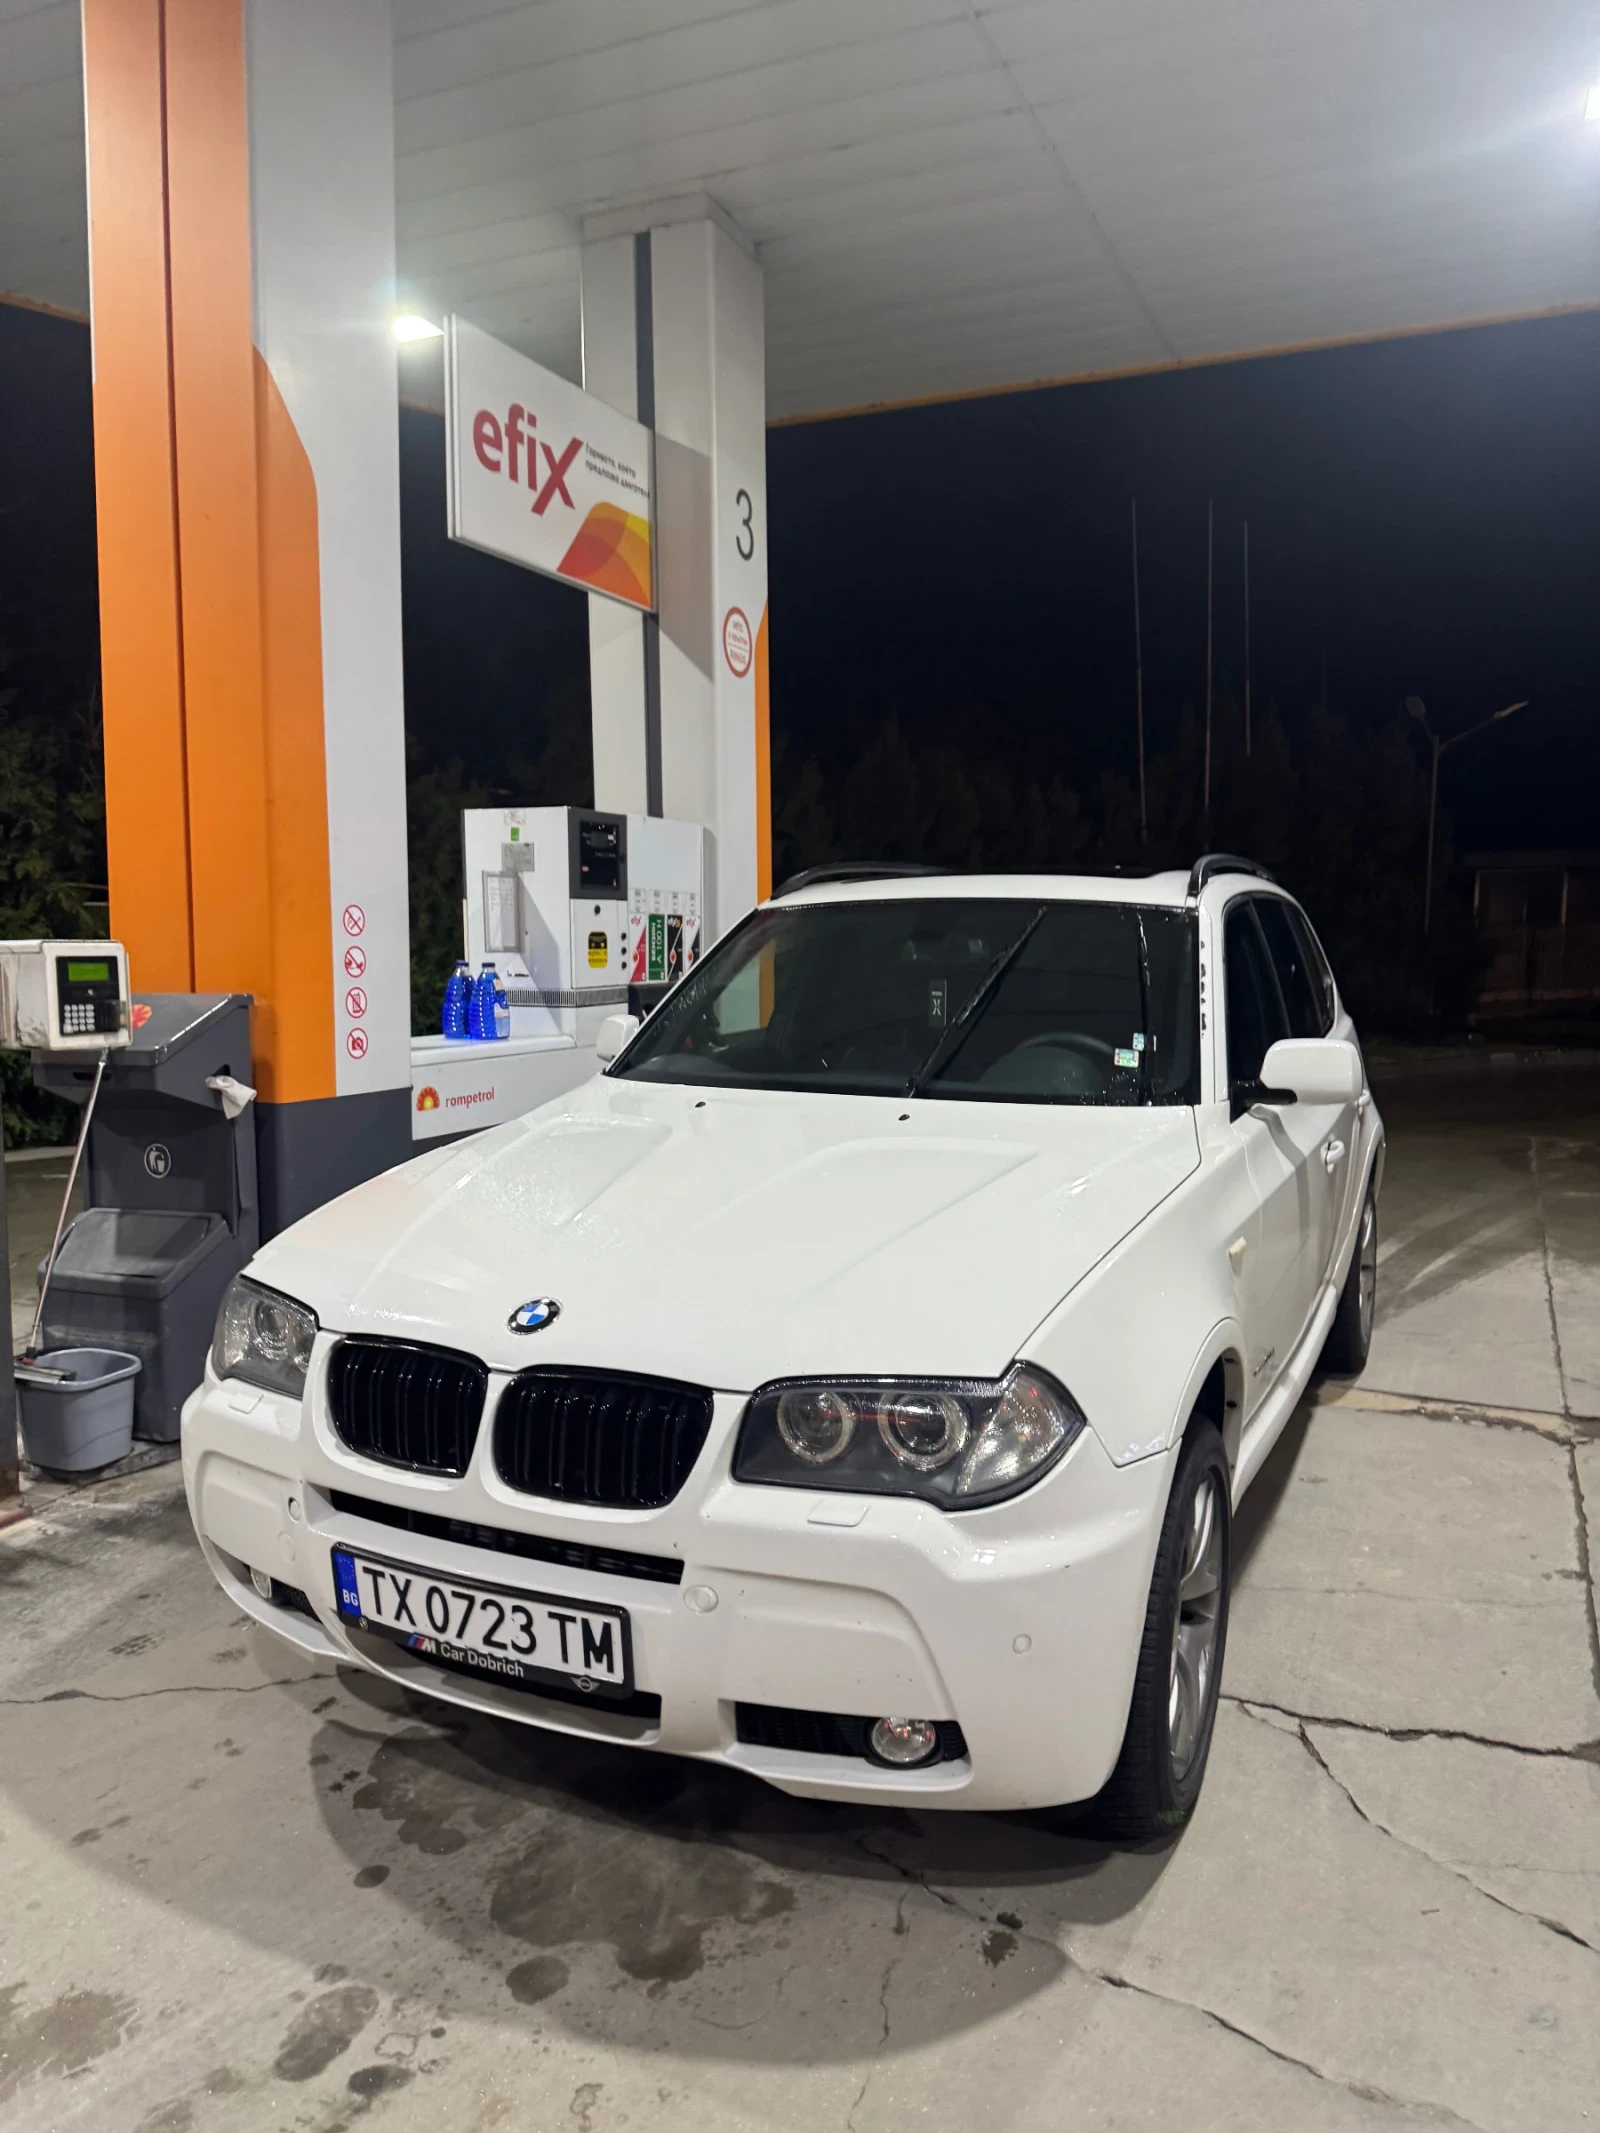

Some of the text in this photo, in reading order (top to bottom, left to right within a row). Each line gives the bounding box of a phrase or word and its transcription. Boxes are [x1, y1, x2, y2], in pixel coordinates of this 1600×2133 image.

[473, 403, 584, 517] efix
[736, 488, 754, 561] 3
[445, 1086, 495, 1109] rompetrol
[342, 1588, 359, 1607] BG
[362, 1566, 614, 1674] TX 0723 TM
[440, 1643, 465, 1661] Car
[467, 1650, 524, 1678] Dobrich
